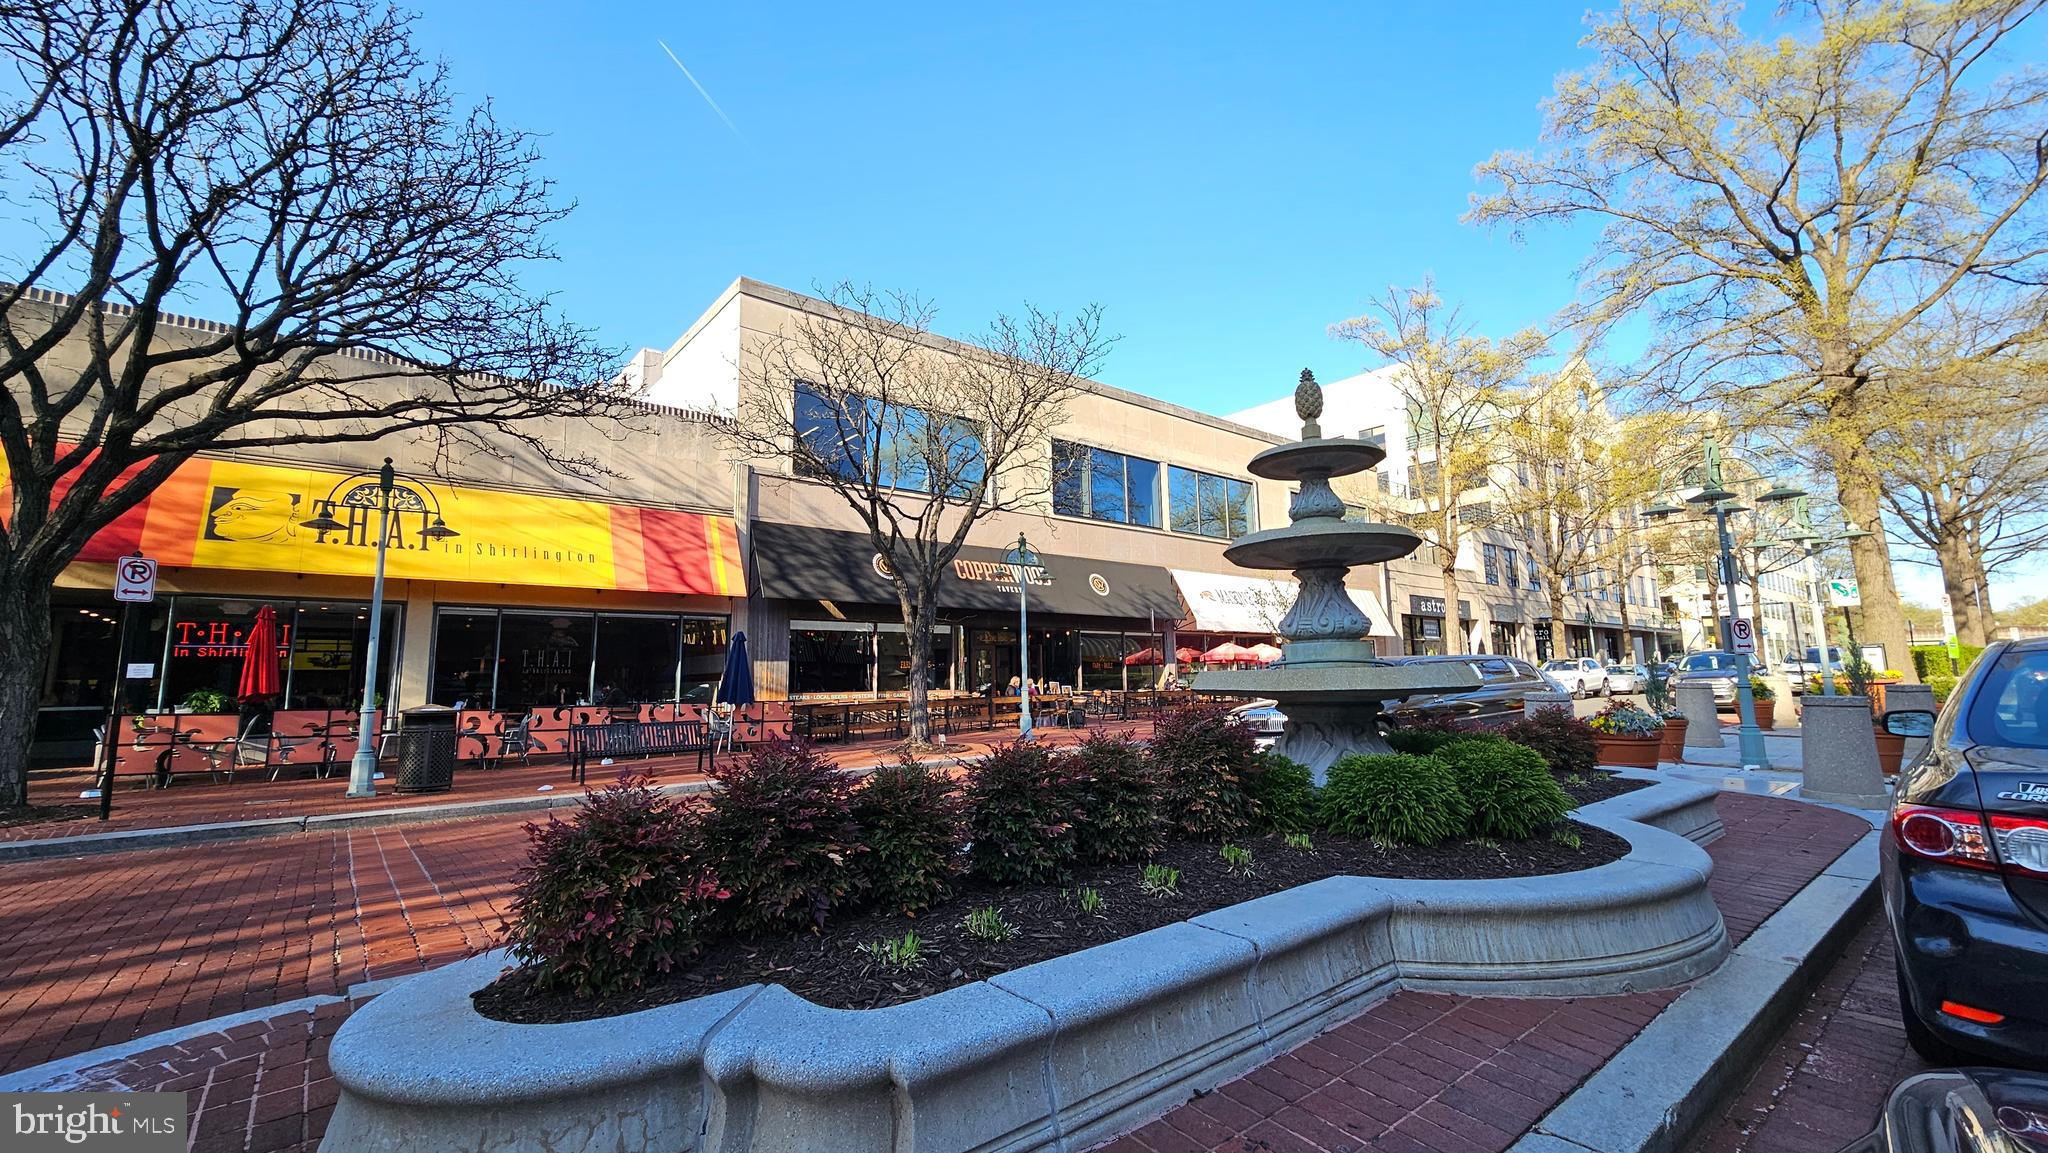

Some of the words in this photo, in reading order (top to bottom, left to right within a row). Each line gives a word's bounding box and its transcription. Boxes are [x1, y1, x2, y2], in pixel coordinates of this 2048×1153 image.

[444, 541, 462, 554] in
[476, 542, 595, 563] Shirlington
[1420, 600, 1446, 613] astro
